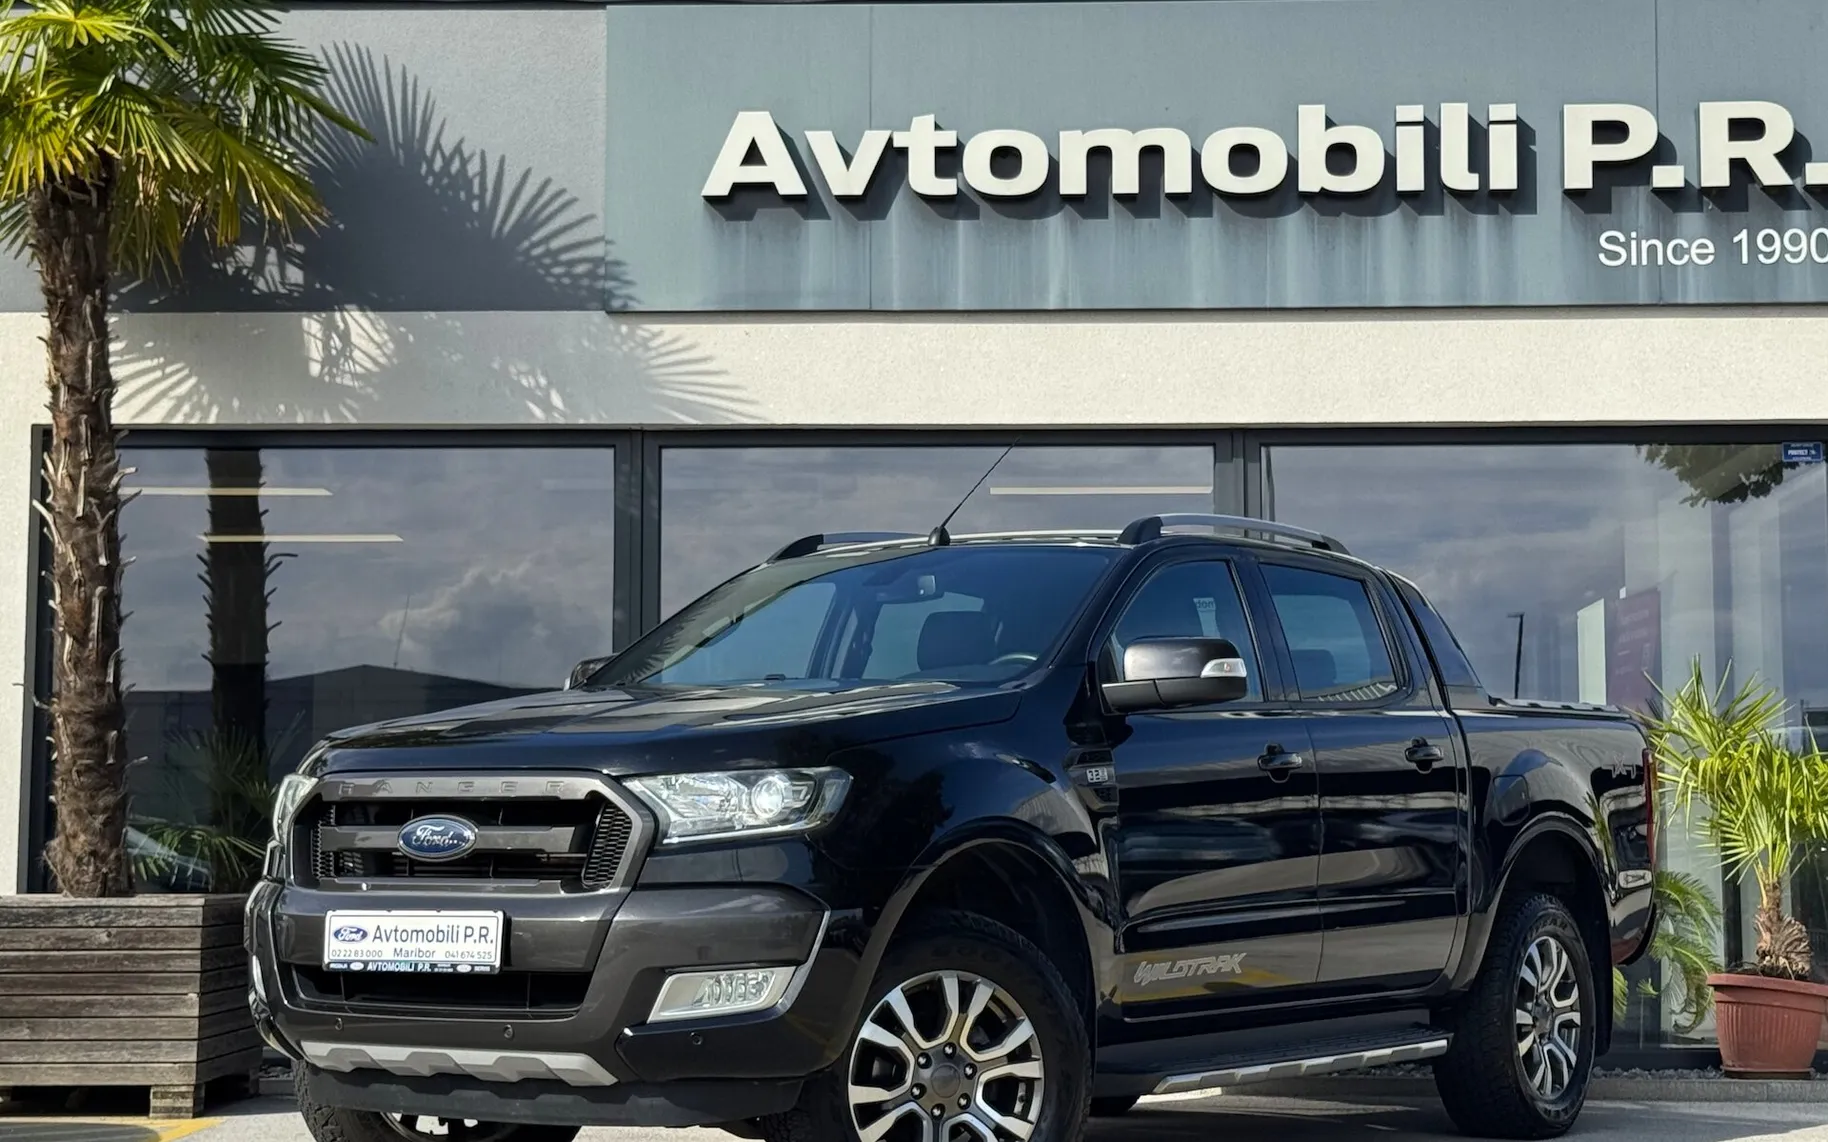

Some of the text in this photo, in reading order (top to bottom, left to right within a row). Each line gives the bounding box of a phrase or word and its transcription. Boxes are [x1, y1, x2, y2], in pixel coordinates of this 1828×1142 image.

[701, 101, 1828, 197] Avtomobili P.R.
[1598, 227, 1828, 267] Since 1990
[338, 779, 564, 796] RANGER
[372, 924, 494, 944] Avtomobili P.R.
[393, 947, 436, 959] Maribor
[366, 961, 415, 973] AVTOMOBILI
[1133, 953, 1247, 986] WILDTRAK
